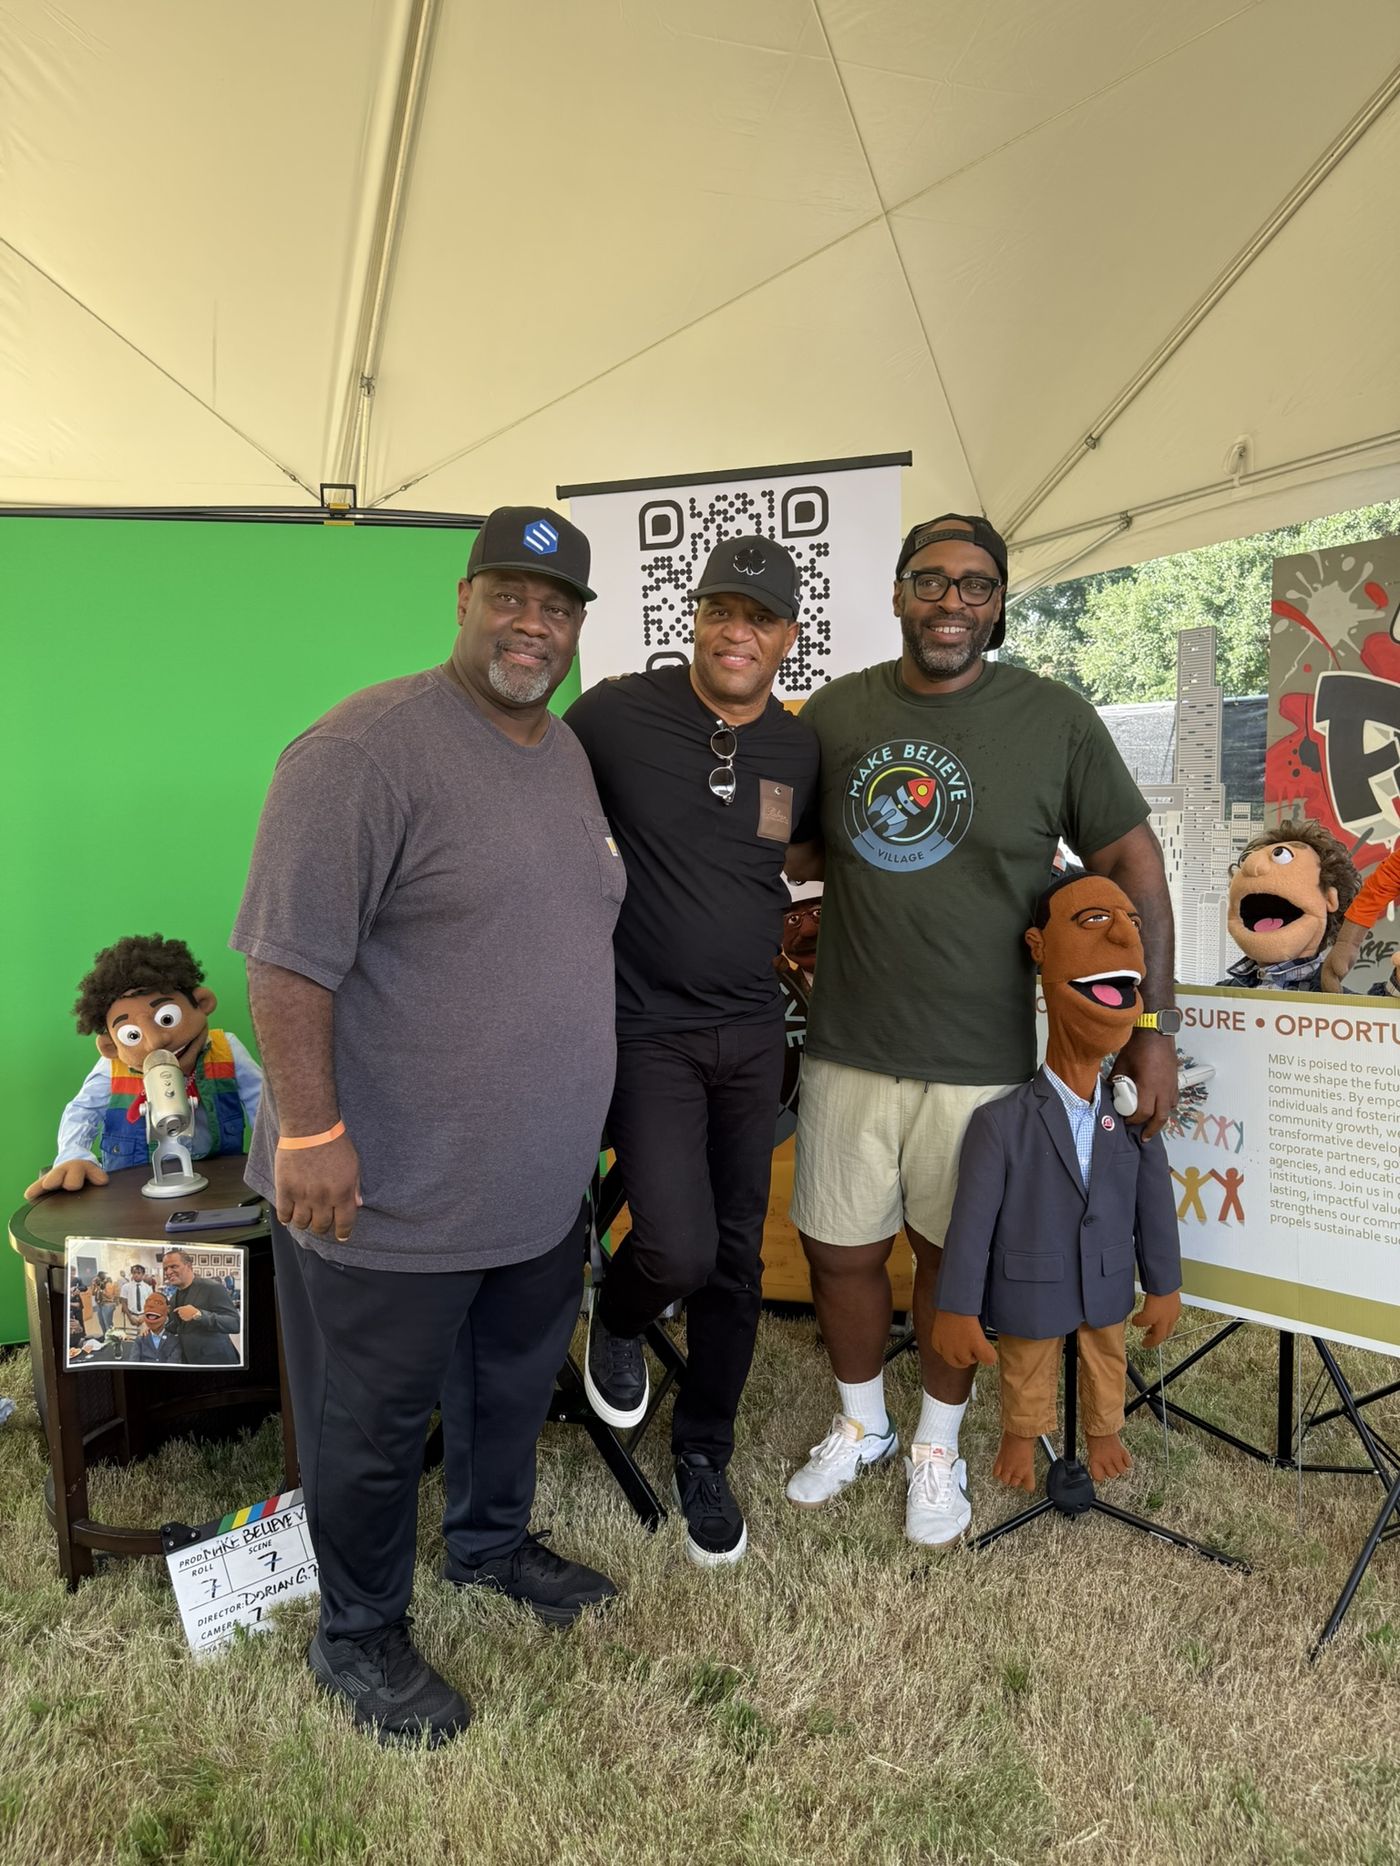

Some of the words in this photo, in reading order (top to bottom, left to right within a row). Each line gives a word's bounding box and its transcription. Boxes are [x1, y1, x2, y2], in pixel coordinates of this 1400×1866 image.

[849, 747, 893, 797] MAKE
[903, 744, 967, 802] BELIEVE
[877, 848, 925, 863] VILLAGE
[1180, 1007, 1247, 1032] SURE
[1268, 1053, 1294, 1066] MBV
[1297, 1056, 1306, 1067] is
[1309, 1059, 1348, 1071] poised
[1350, 1062, 1363, 1073] to
[1268, 1068, 1291, 1080] how
[1294, 1073, 1311, 1083] we
[1313, 1073, 1348, 1088] shape
[1351, 1077, 1371, 1089] the
[1268, 1084, 1346, 1101] communities.
[1349, 1091, 1364, 1106] By
[1268, 1096, 1328, 1114] individuals
[1331, 1106, 1353, 1117] and
[1268, 1113, 1333, 1132] community
[1336, 1122, 1382, 1138] growth,
[1269, 1126, 1353, 1147] transformative
[1269, 1142, 1323, 1158] corporate
[1327, 1151, 1380, 1168] partners,
[1269, 1156, 1321, 1174] agencies,
[1324, 1165, 1346, 1176] and
[1269, 1169, 1336, 1190] institutions.
[1339, 1180, 1363, 1194] Join
[1366, 1188, 1380, 1197] us
[1383, 1187, 1394, 1199] in
[1269, 1183, 1310, 1202] lasting,
[1313, 1191, 1369, 1210] impactful
[1270, 1199, 1337, 1219] strengthens
[1340, 1212, 1361, 1222] our
[1270, 1213, 1311, 1228] propels
[1314, 1221, 1381, 1242] sustainable
[243, 1513, 292, 1543] BELIEVE
[248, 1539, 273, 1555] SCENE
[191, 1563, 214, 1577] ROLL
[257, 1550, 283, 1572] 7
[200, 1578, 222, 1599] 7
[237, 1577, 294, 1606] DORIAN
[197, 1602, 245, 1627] DIRECTOR:
[248, 1606, 262, 1621] 7
